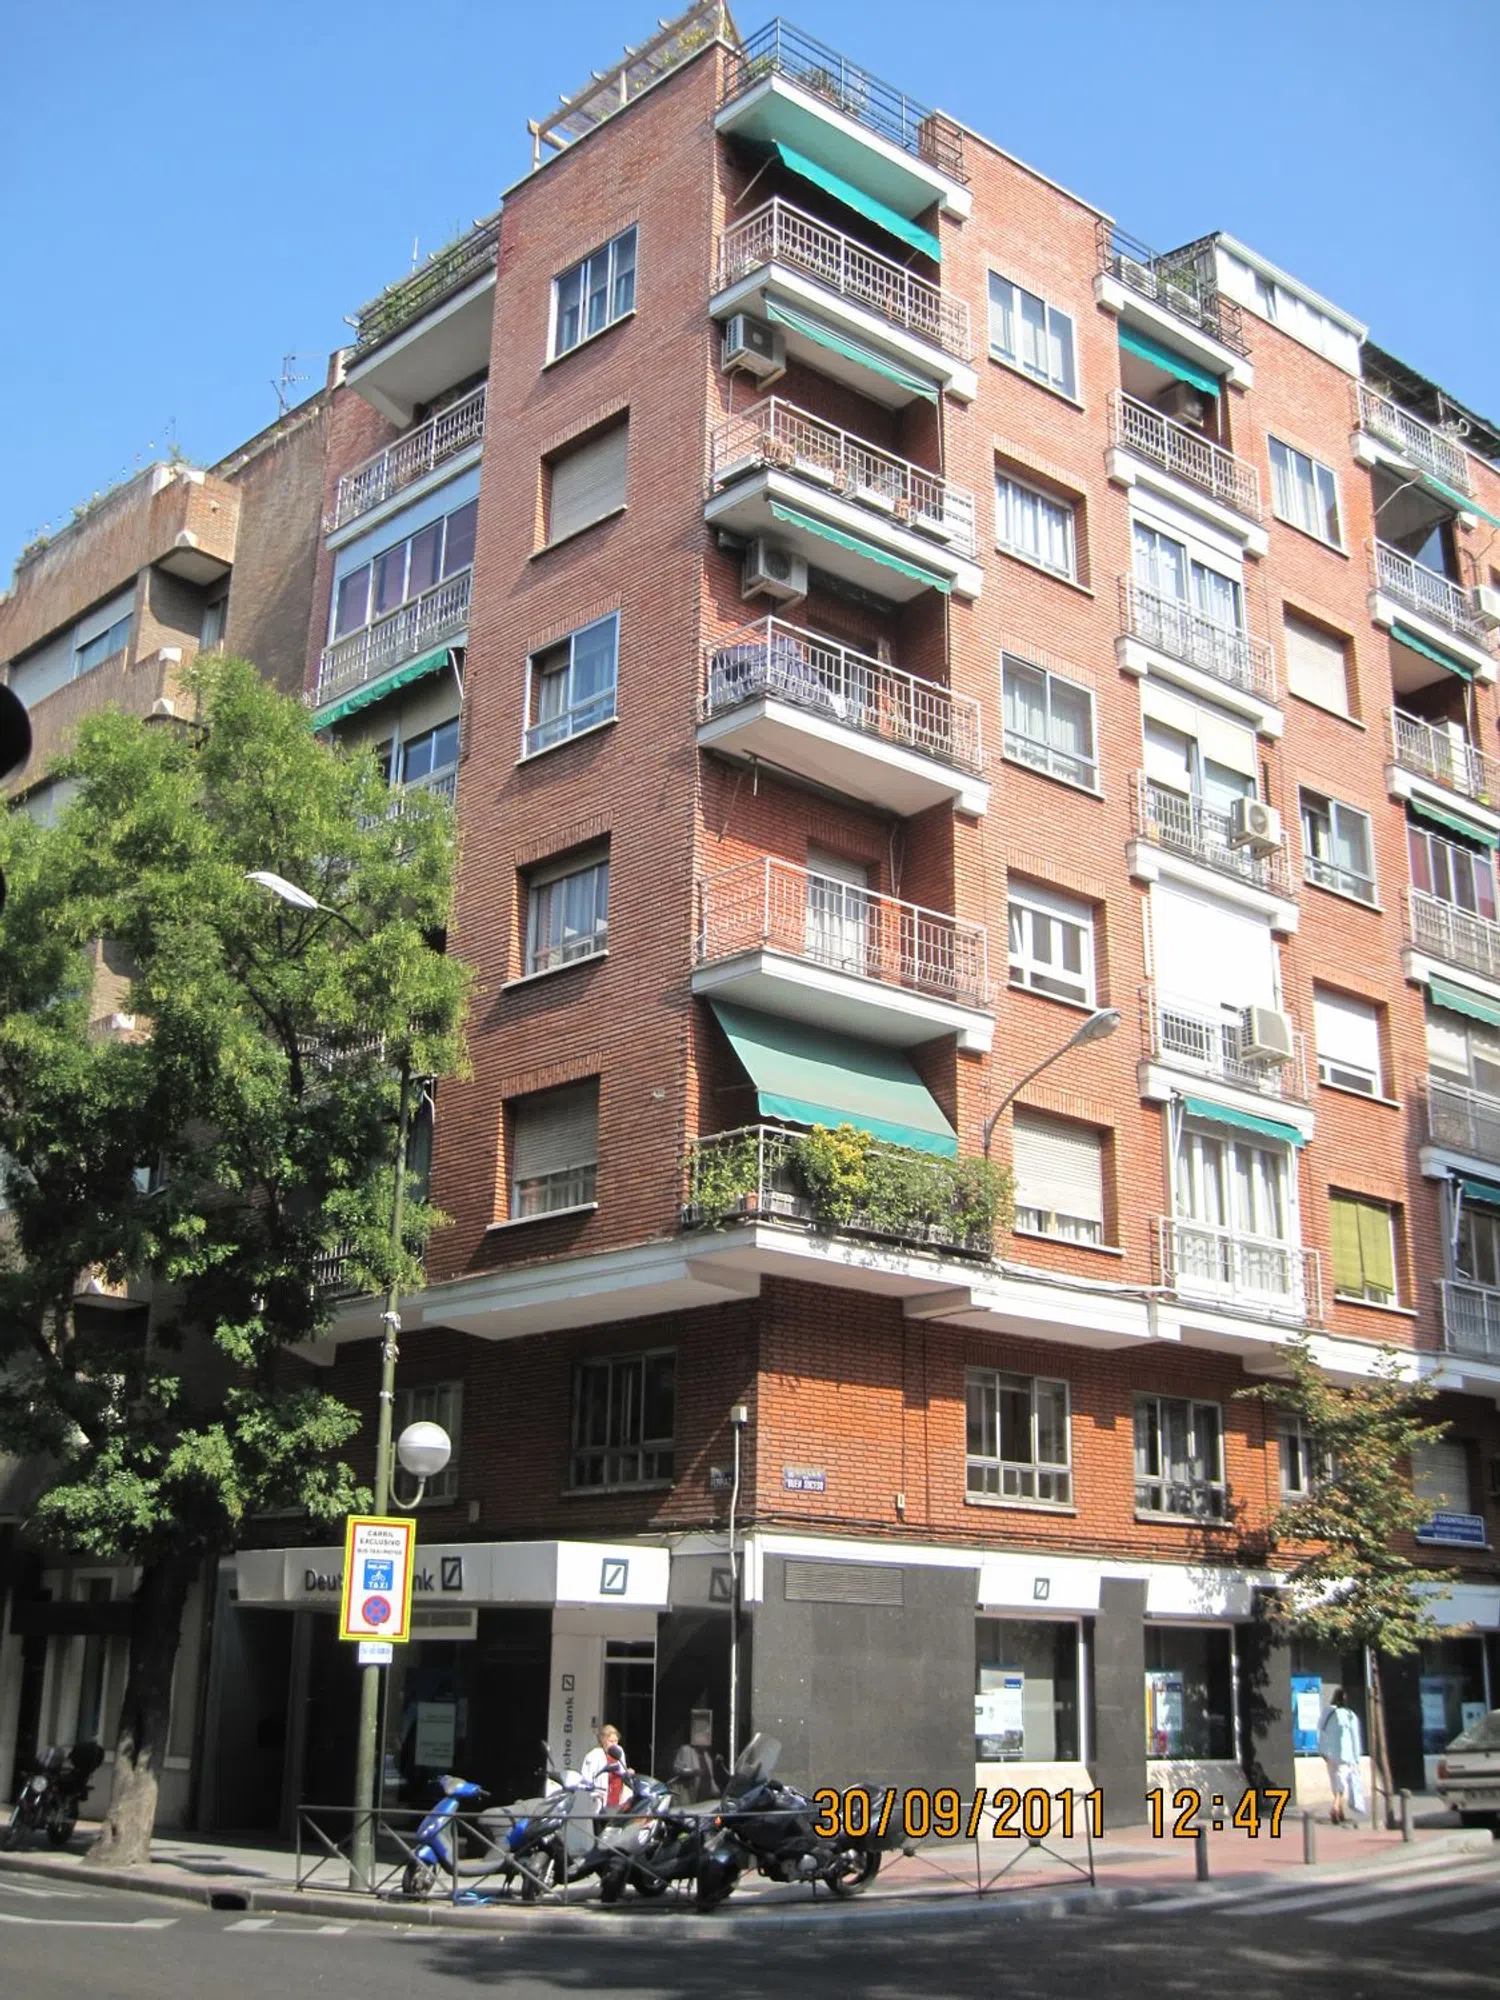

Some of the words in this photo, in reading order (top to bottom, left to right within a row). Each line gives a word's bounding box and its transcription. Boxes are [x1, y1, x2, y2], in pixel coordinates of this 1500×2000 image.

[367, 1530, 394, 1538] CARRIL
[360, 1538, 401, 1547] EXCLUSIVO
[304, 1569, 344, 1592] Deut
[412, 1568, 435, 1591] nk
[367, 1581, 389, 1589] TAXI
[563, 1696, 574, 1733] Bank
